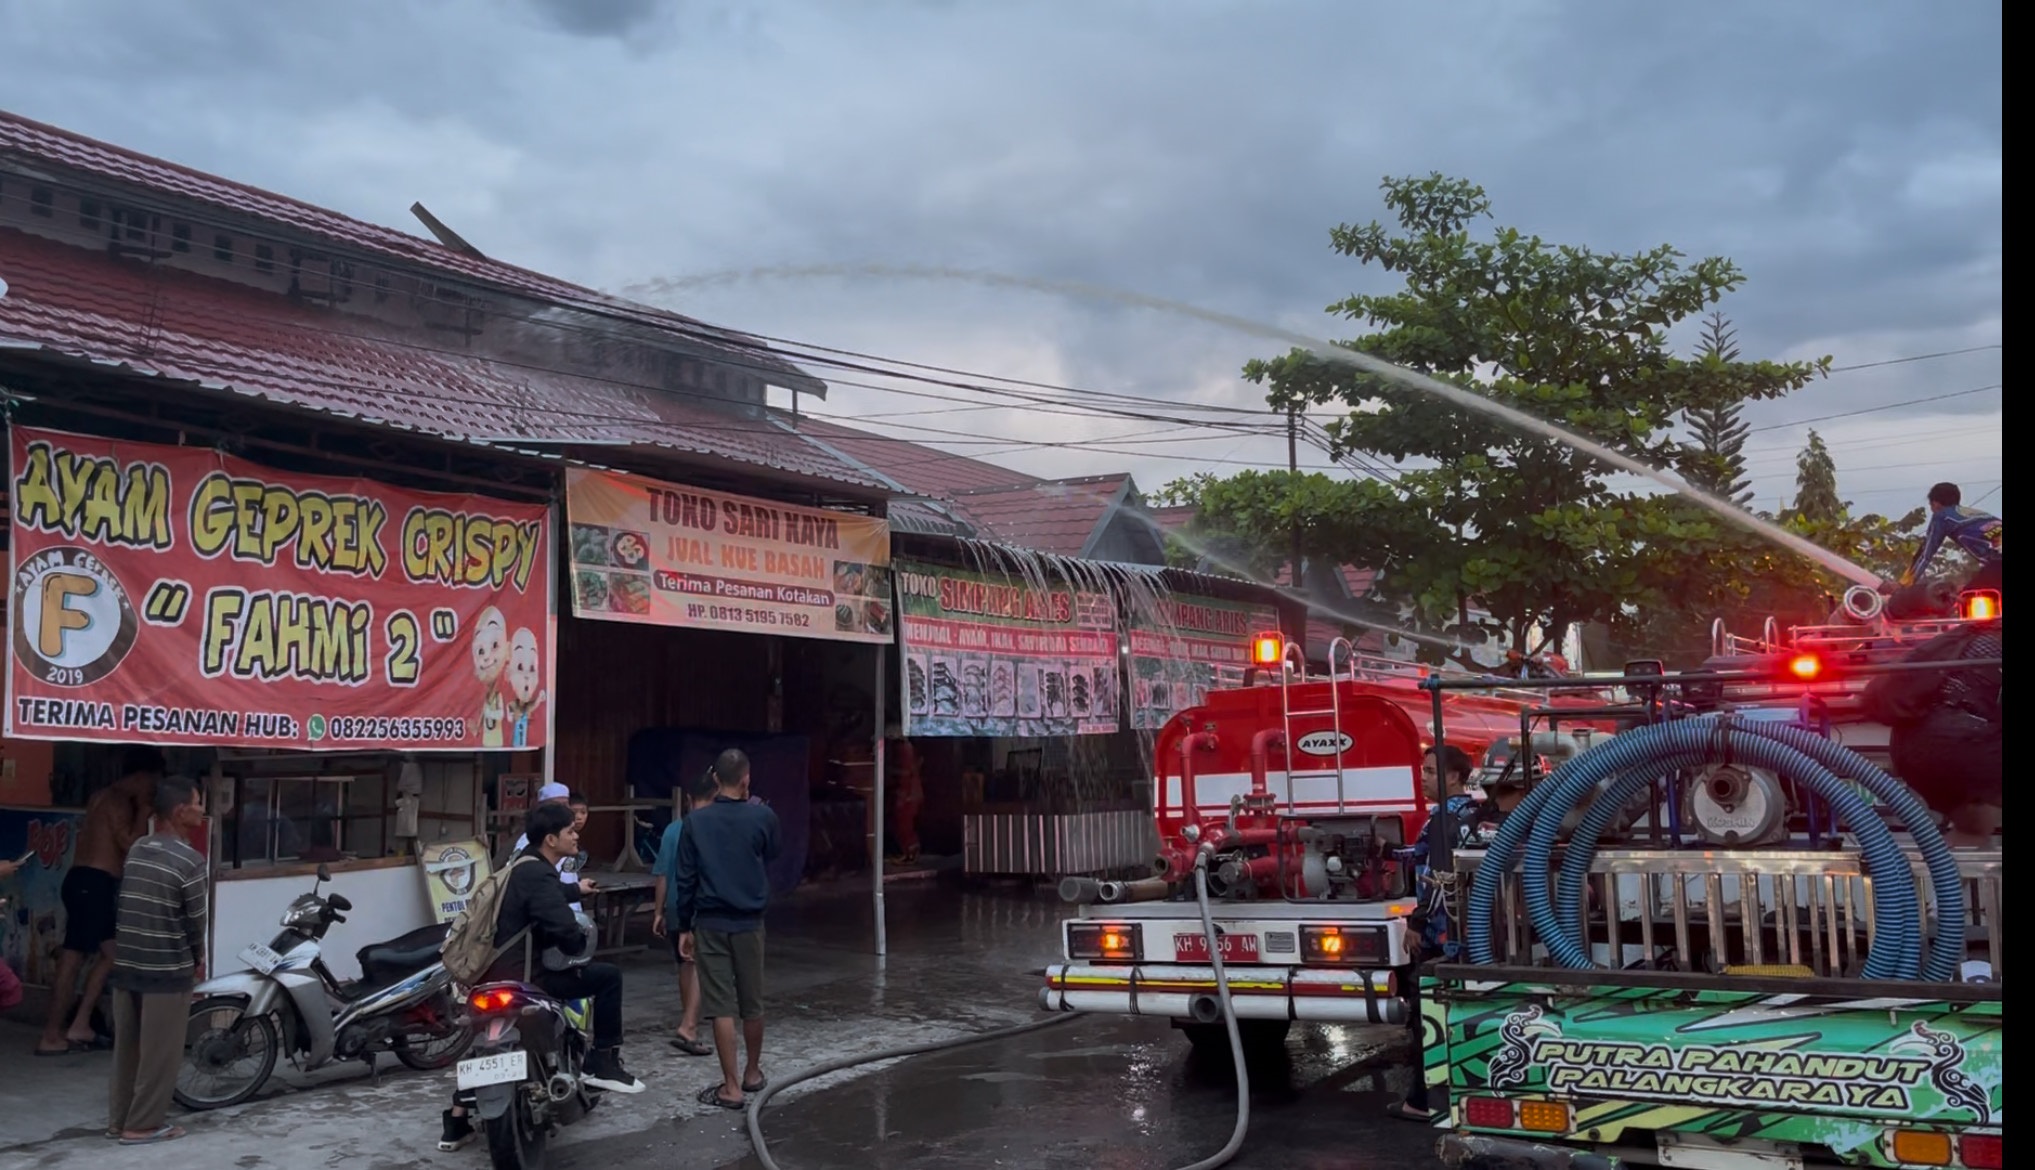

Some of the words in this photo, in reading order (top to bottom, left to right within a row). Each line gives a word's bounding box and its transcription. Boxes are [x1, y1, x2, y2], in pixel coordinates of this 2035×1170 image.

[17, 442, 173, 549] AYAM
[189, 471, 387, 578] GEPREK
[402, 507, 541, 592] CRISPY
[645, 487, 717, 531] TOKO
[722, 500, 780, 540] SARI
[784, 511, 840, 549] KAYA
[19, 550, 64, 587] AYAM
[667, 535, 713, 566] JUAL
[721, 544, 758, 572] KUE
[764, 550, 825, 580] BASAH
[659, 573, 711, 593] Terima
[715, 578, 773, 600] Pesanan
[777, 586, 830, 605] Kotakan
[901, 572, 936, 597] TOKO
[688, 603, 708, 618] HP.
[709, 605, 743, 622] 0813
[745, 609, 777, 624] 5195
[389, 611, 420, 685] 2
[46, 666, 83, 684] 2019
[19, 698, 115, 728] TERIMA
[123, 706, 238, 735] PESANAN
[244, 713, 299, 738] HUB:
[331, 716, 465, 740] 082256355993
[1176, 936, 1193, 952] KH
[459, 1063, 472, 1075] KH
[479, 1058, 504, 1071] 4551
[1534, 1041, 1672, 1068] PUTRA
[1680, 1047, 1931, 1084] PAHANDUT
[1552, 1065, 1911, 1110] PALANGKARAYA
